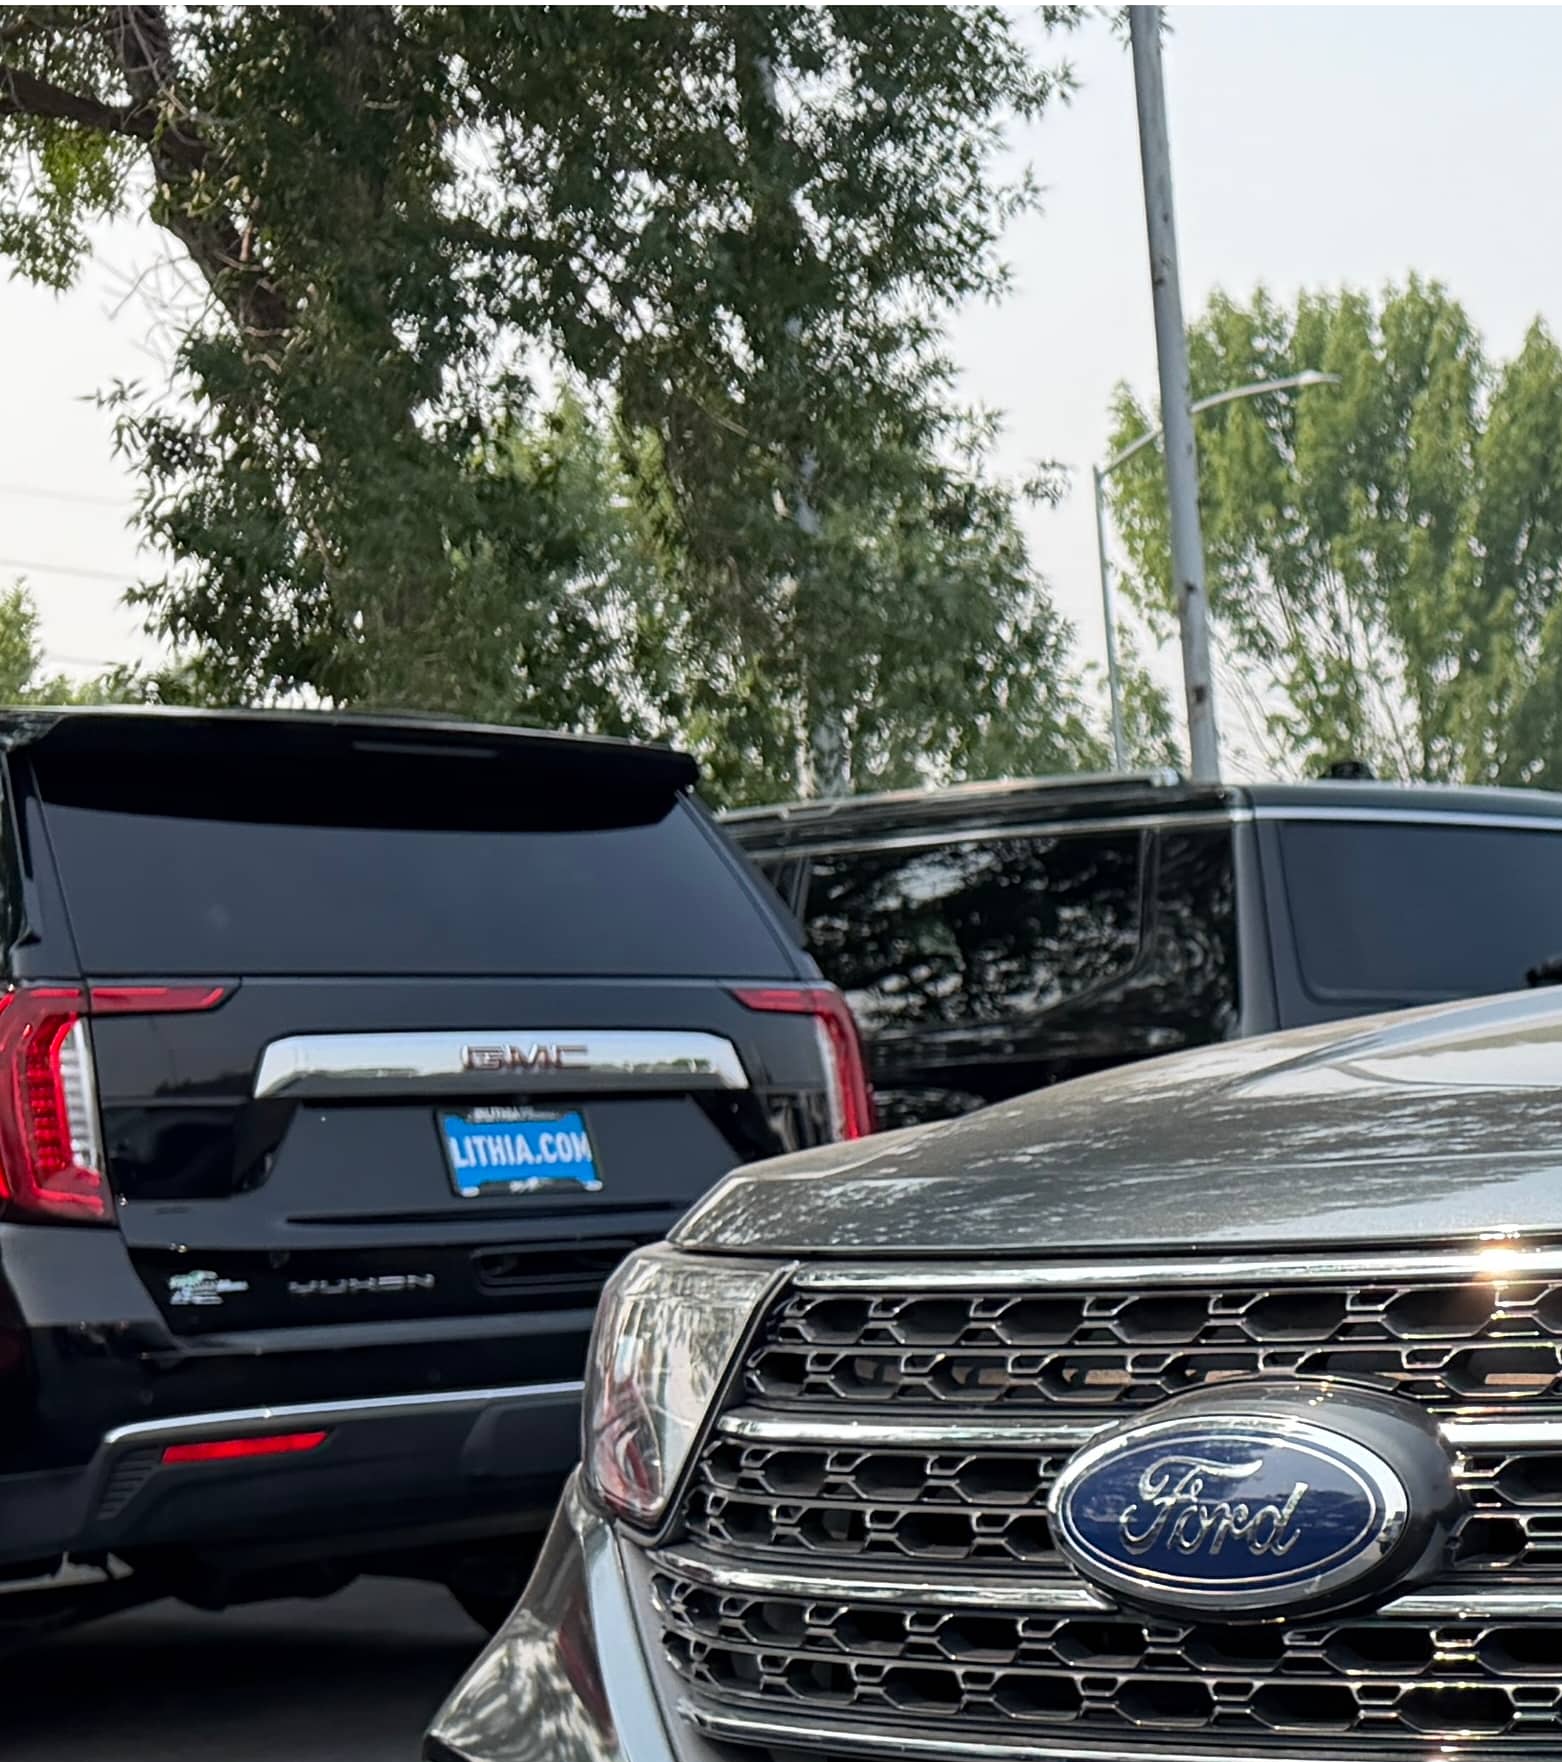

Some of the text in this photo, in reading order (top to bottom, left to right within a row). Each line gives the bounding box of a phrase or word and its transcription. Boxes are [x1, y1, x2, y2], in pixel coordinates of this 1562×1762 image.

[462, 1045, 590, 1071] GMC
[449, 1132, 592, 1168] LITHIA.COM
[1119, 1455, 1310, 1556] Ford
